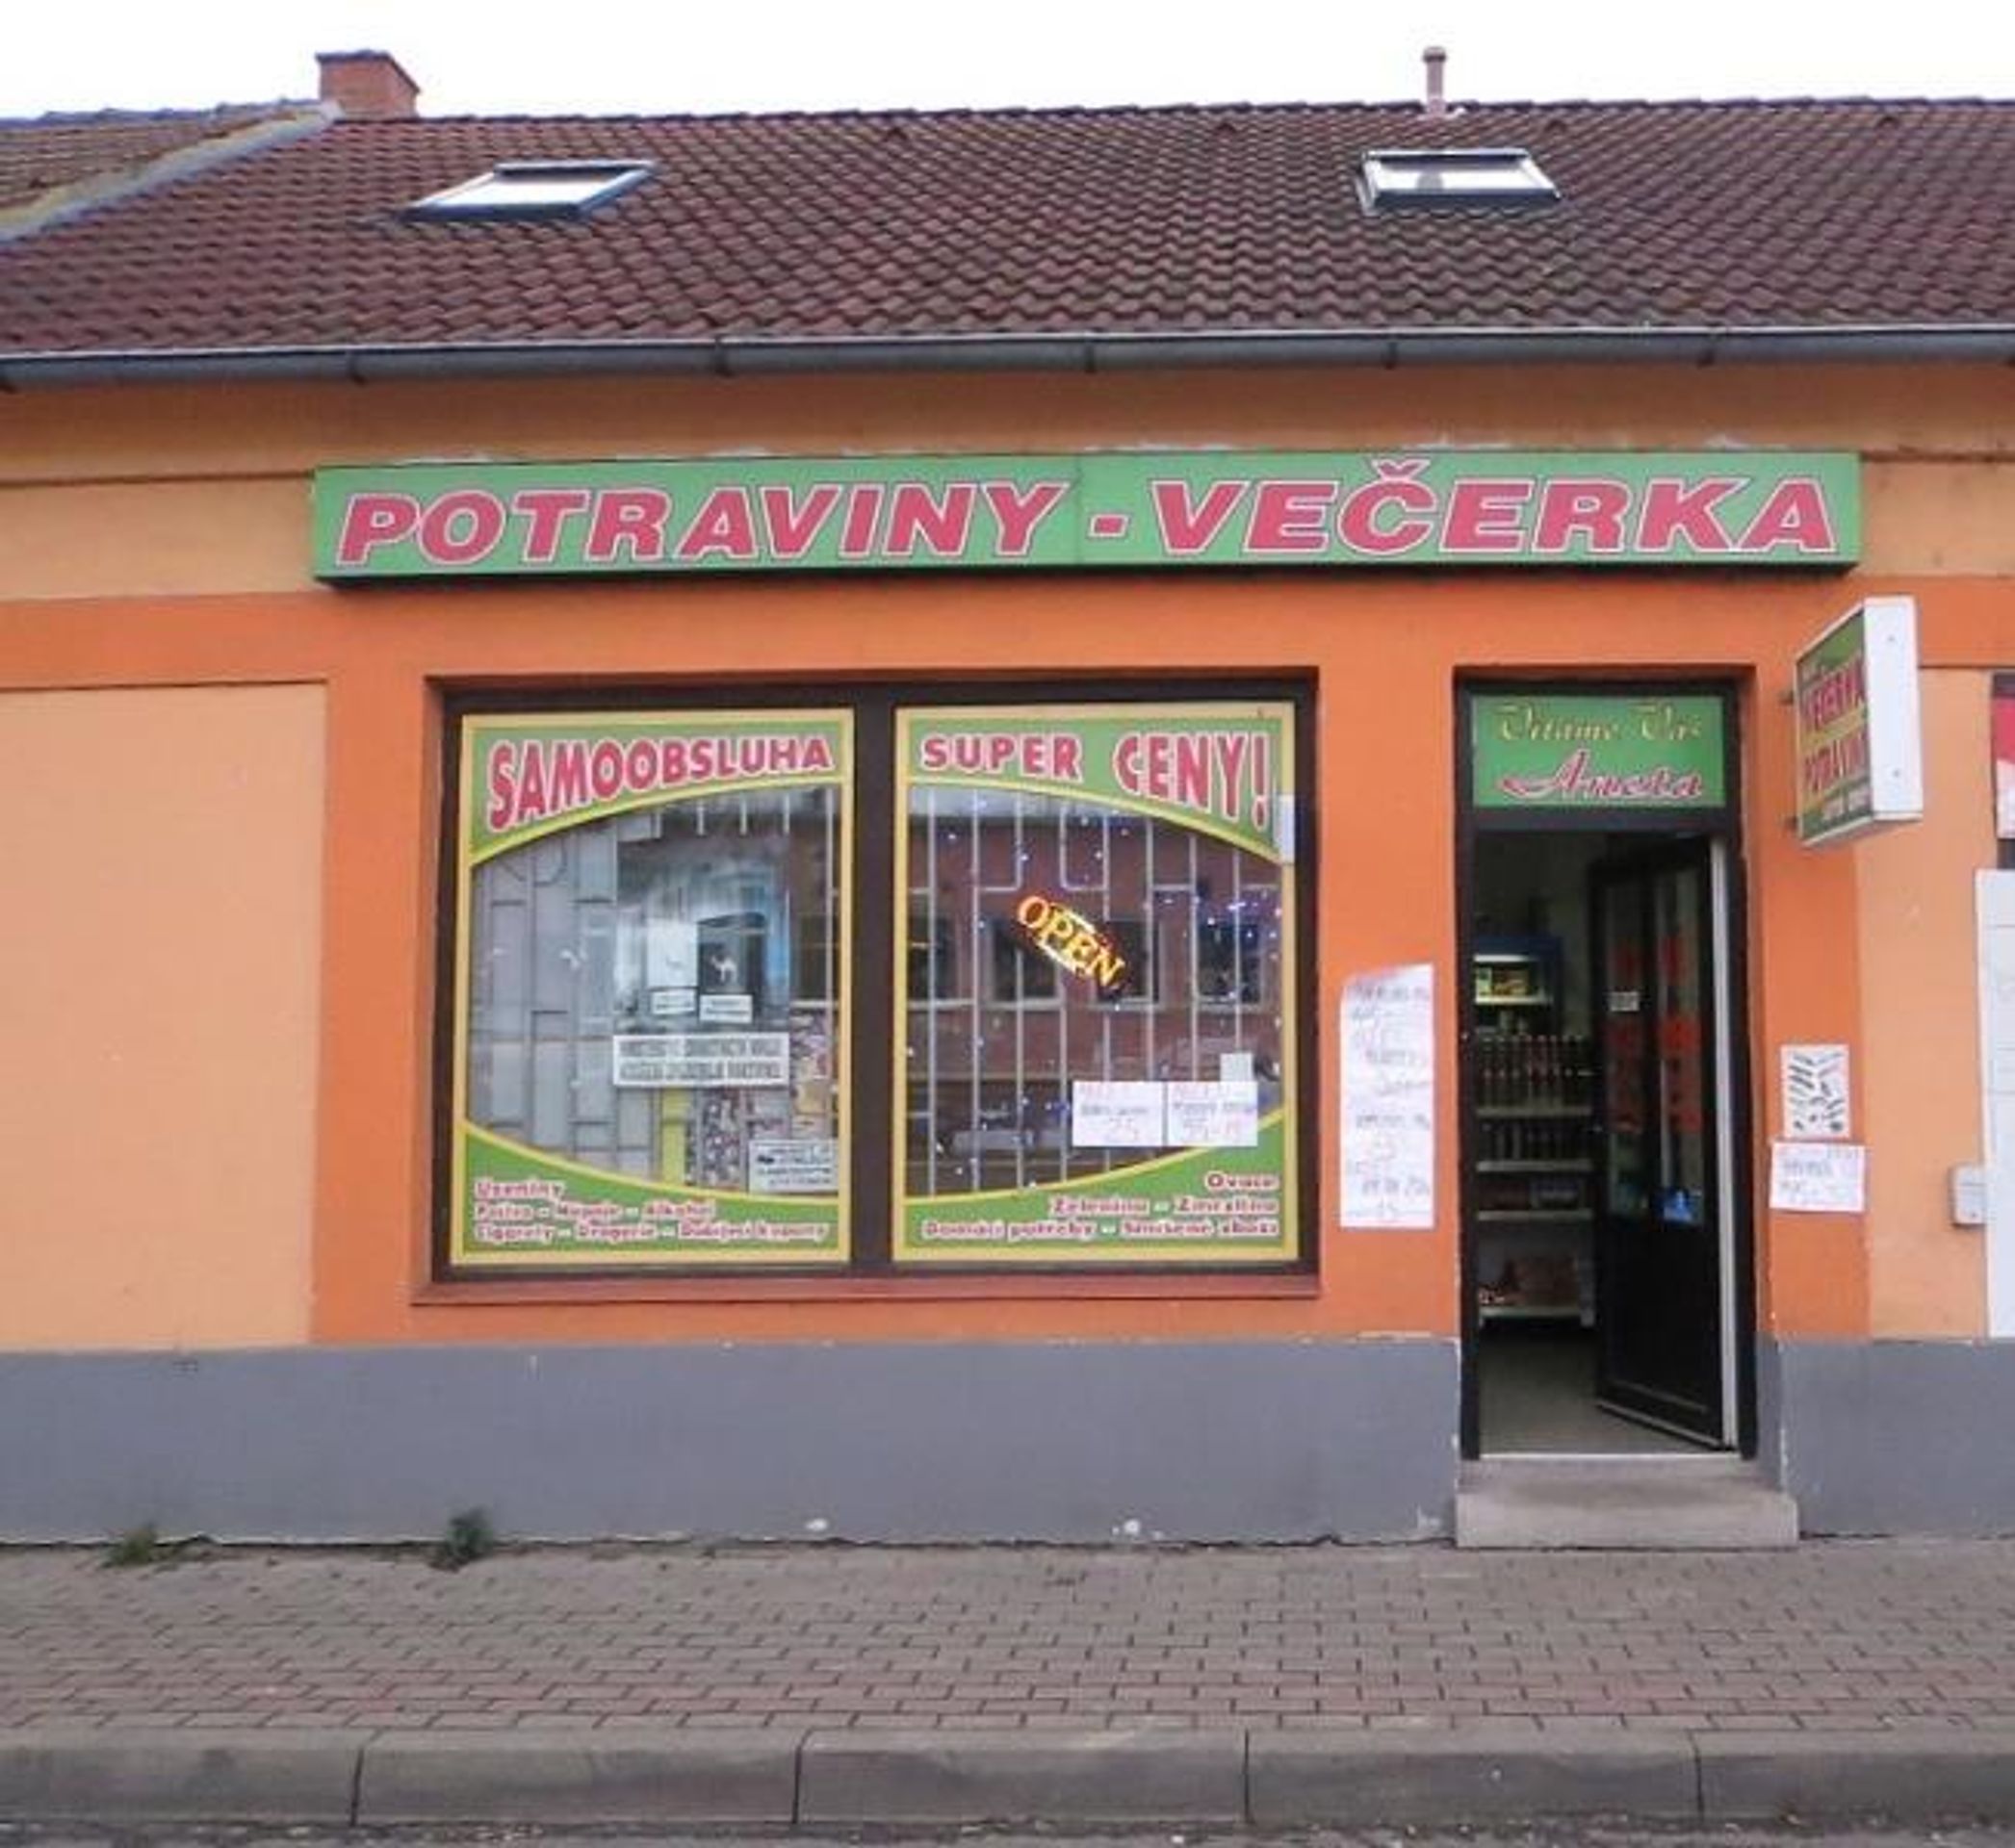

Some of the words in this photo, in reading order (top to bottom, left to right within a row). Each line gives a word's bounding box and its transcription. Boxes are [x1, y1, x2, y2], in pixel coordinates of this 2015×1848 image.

[337, 481, 1072, 565] POTRAVINY
[1150, 457, 1837, 555] VEČERKA
[487, 734, 837, 833] SAMOOBSLUHA
[921, 732, 1084, 783] SUPER
[1112, 730, 1271, 831] CENY!
[1017, 895, 1126, 988] OPEN
